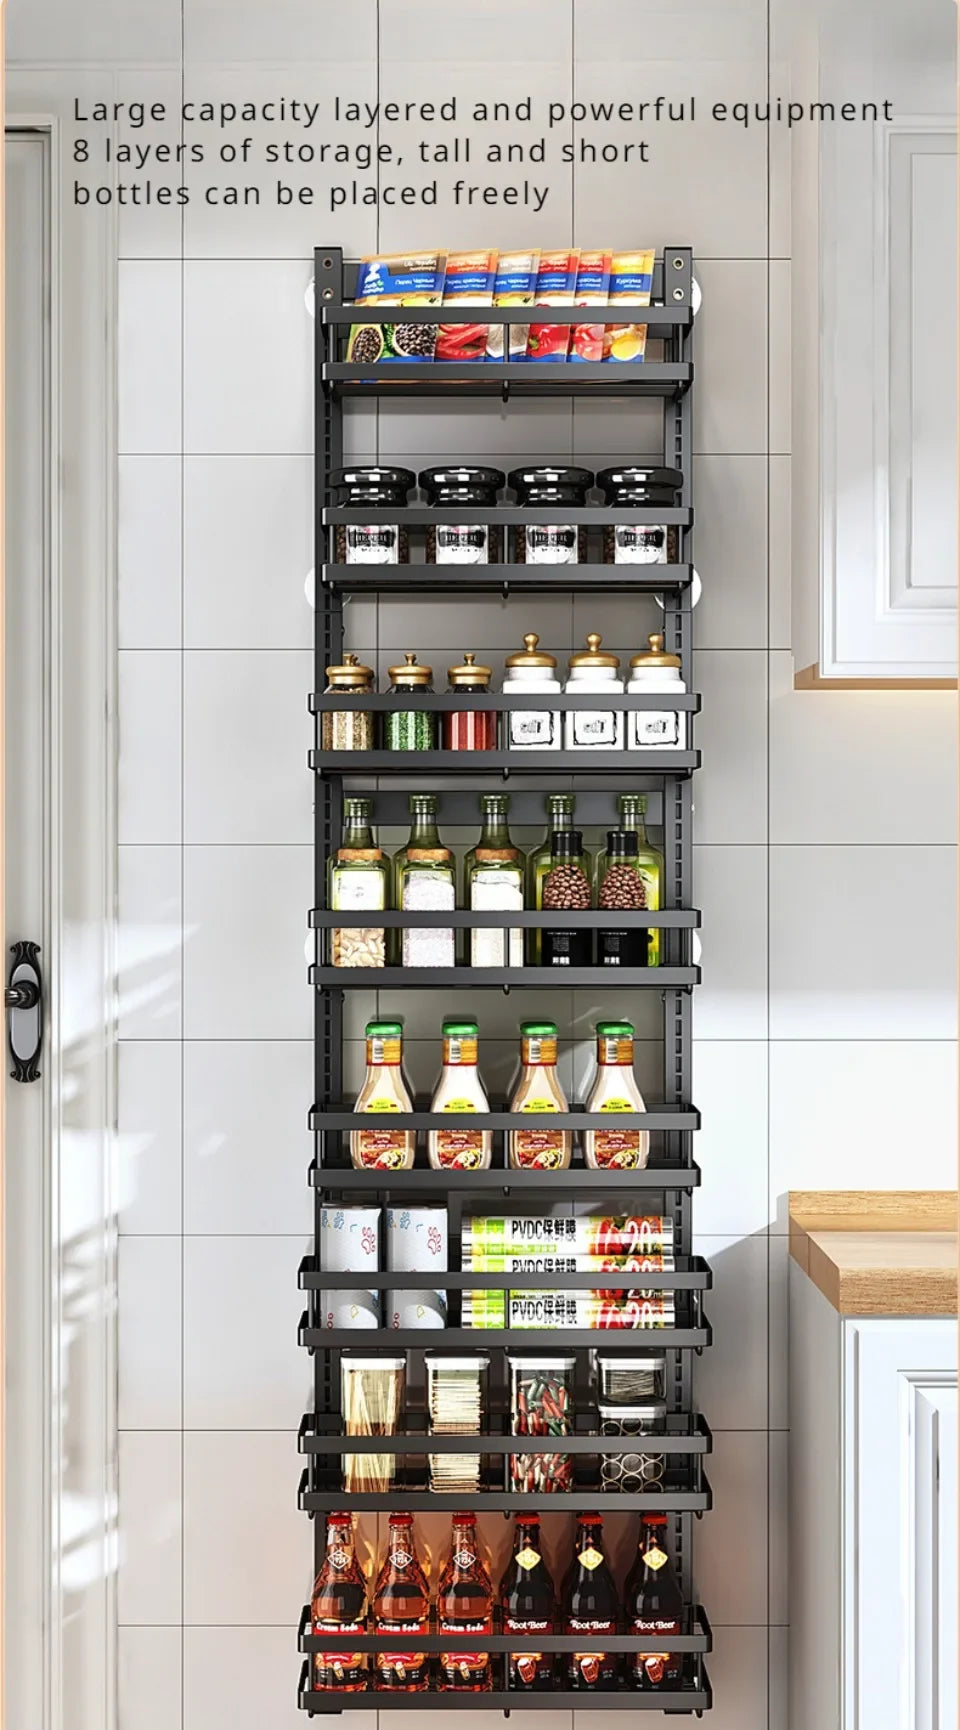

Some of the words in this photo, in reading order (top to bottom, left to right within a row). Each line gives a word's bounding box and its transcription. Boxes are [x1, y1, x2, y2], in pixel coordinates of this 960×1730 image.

[507, 1619, 527, 1630] Root
[527, 1621, 548, 1630] Beer
[570, 1619, 590, 1630] Root
[590, 1621, 611, 1630] Beer
[634, 1619, 654, 1630] Root
[656, 1621, 675, 1630] Beer
